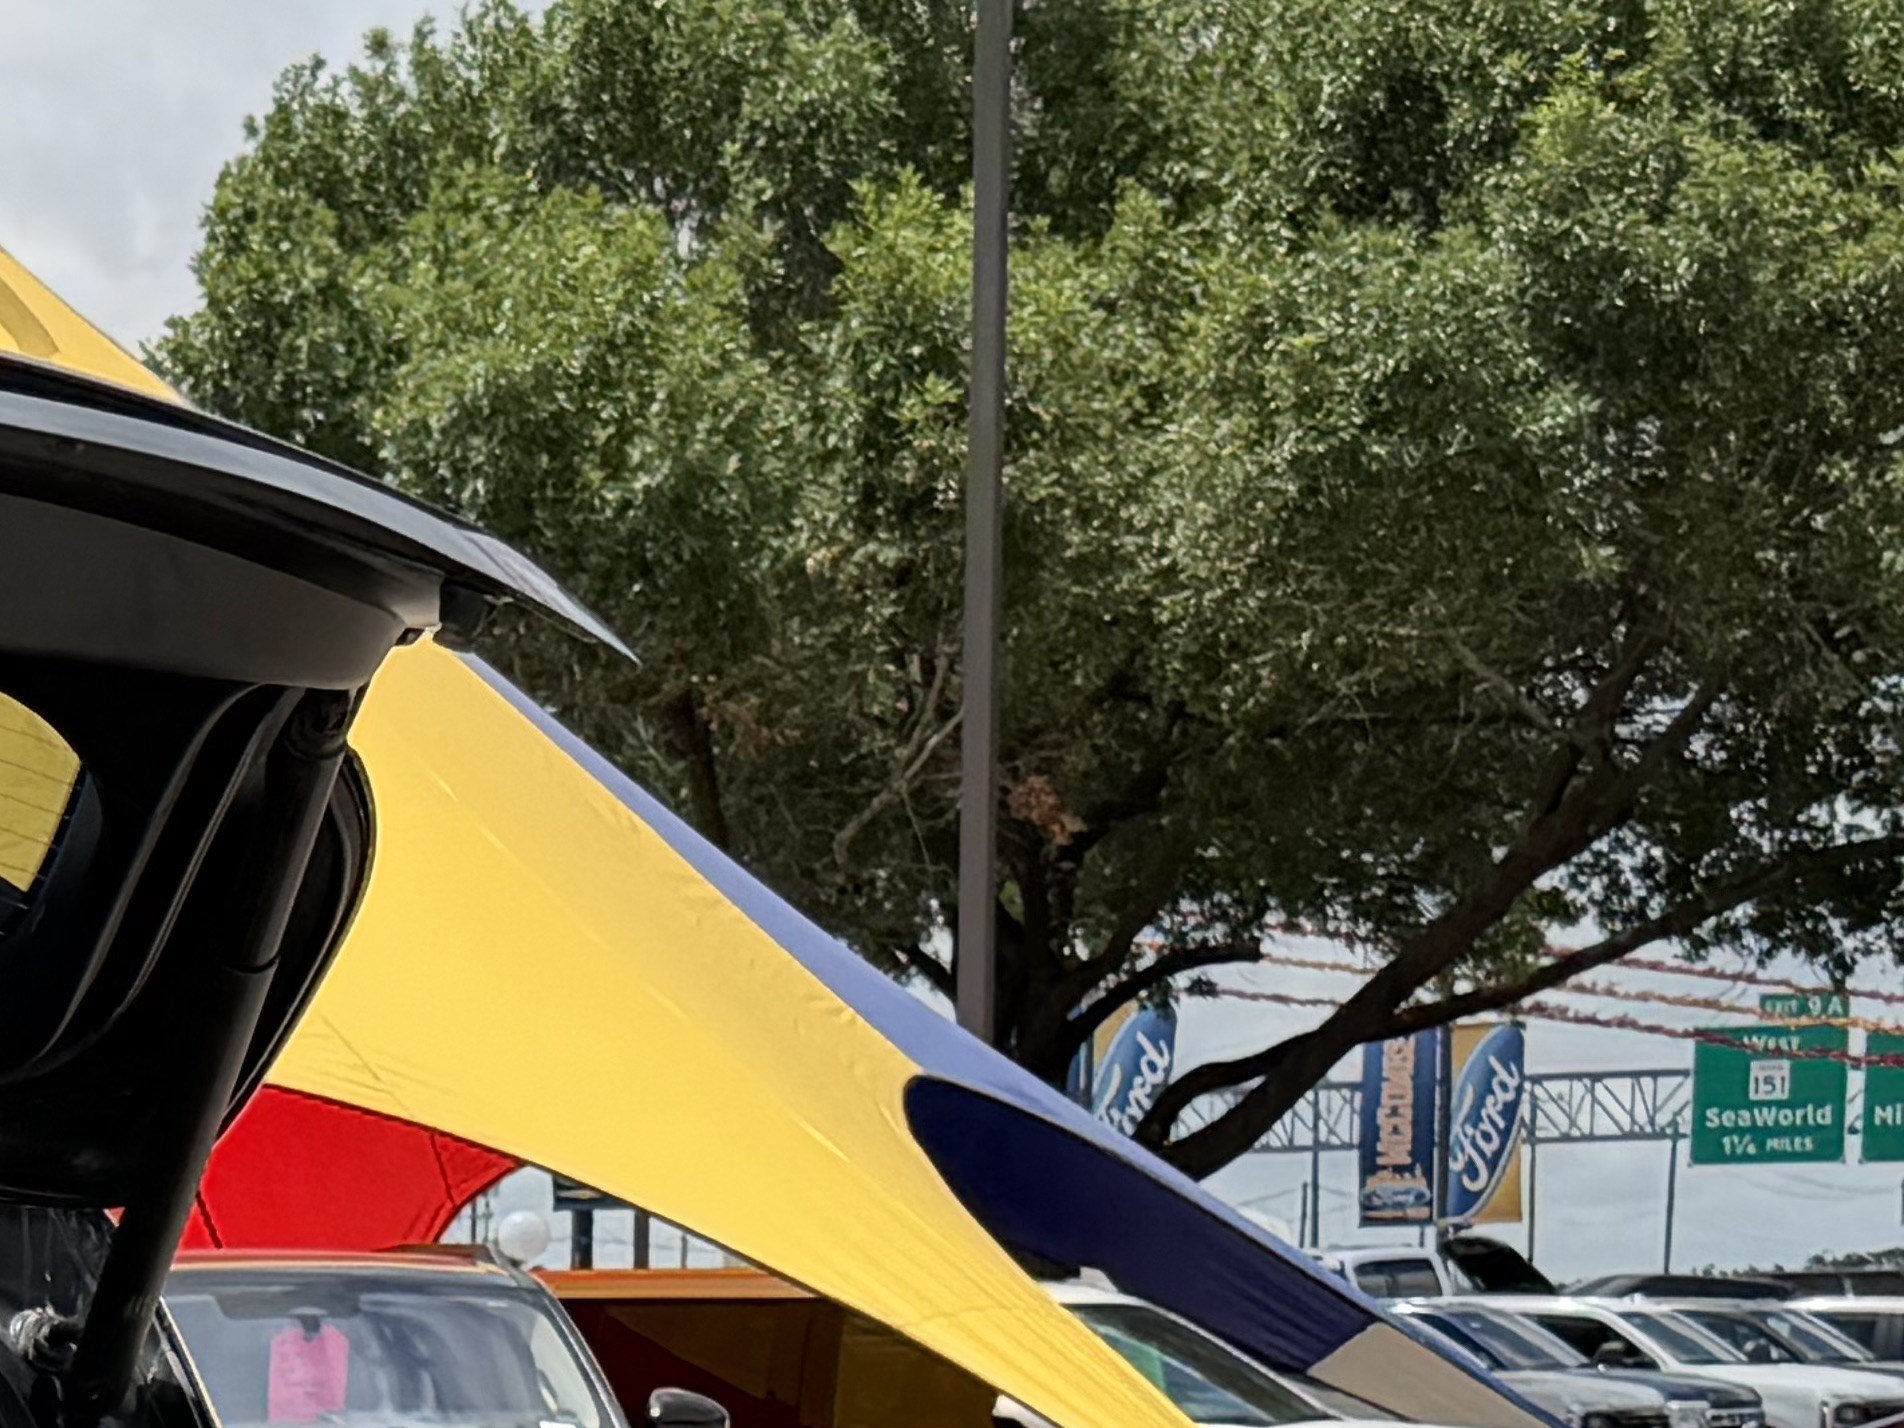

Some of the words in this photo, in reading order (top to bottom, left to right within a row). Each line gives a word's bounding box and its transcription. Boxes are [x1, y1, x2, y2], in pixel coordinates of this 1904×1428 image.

[1753, 1075, 1787, 1096] 151
[1448, 1055, 1520, 1192] Ford
[1705, 1102, 1833, 1128] SeaWorld
